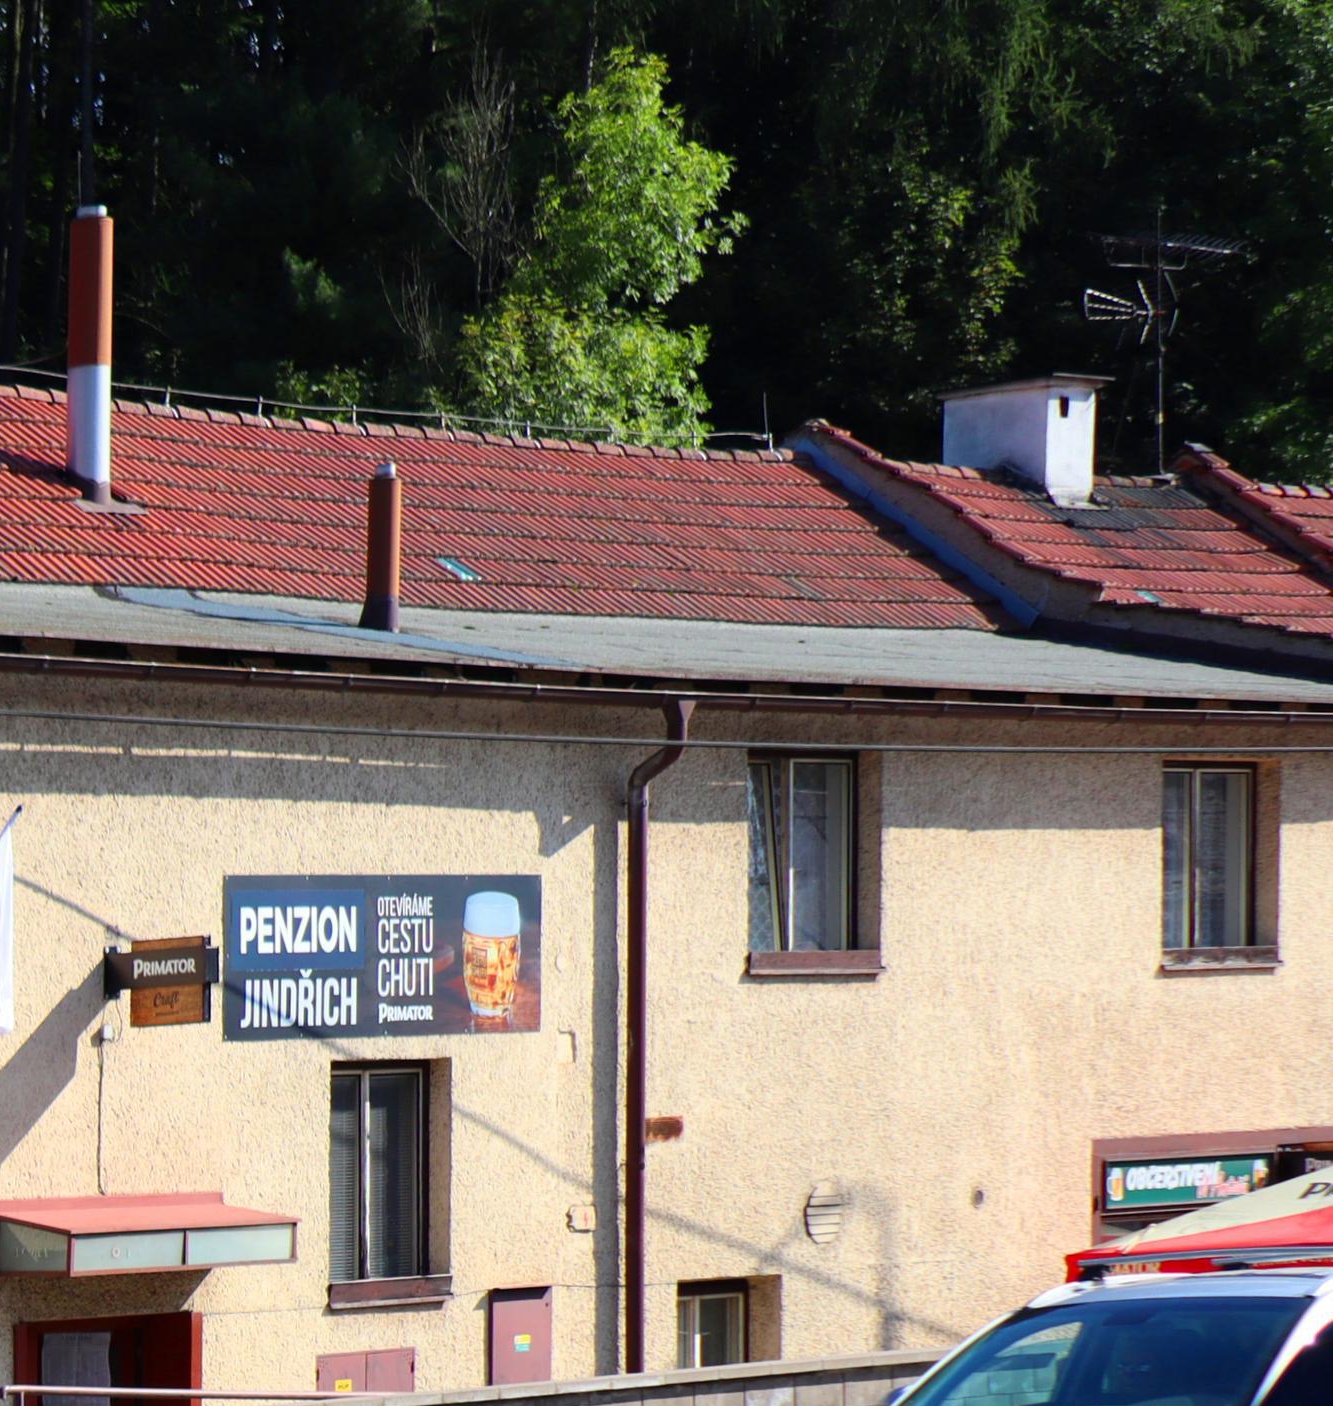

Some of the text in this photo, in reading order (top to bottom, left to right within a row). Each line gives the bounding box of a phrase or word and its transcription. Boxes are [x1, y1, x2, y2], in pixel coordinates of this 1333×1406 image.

[377, 893, 433, 917] OTEVÍRÁME
[240, 905, 357, 954] PENZION
[377, 918, 433, 954] CESTU
[133, 958, 196, 979] PRIMATOR
[377, 958, 433, 997] CHUTI
[240, 968, 357, 1029] JINDŘICH
[378, 1002, 433, 1024] PRIMATOR
